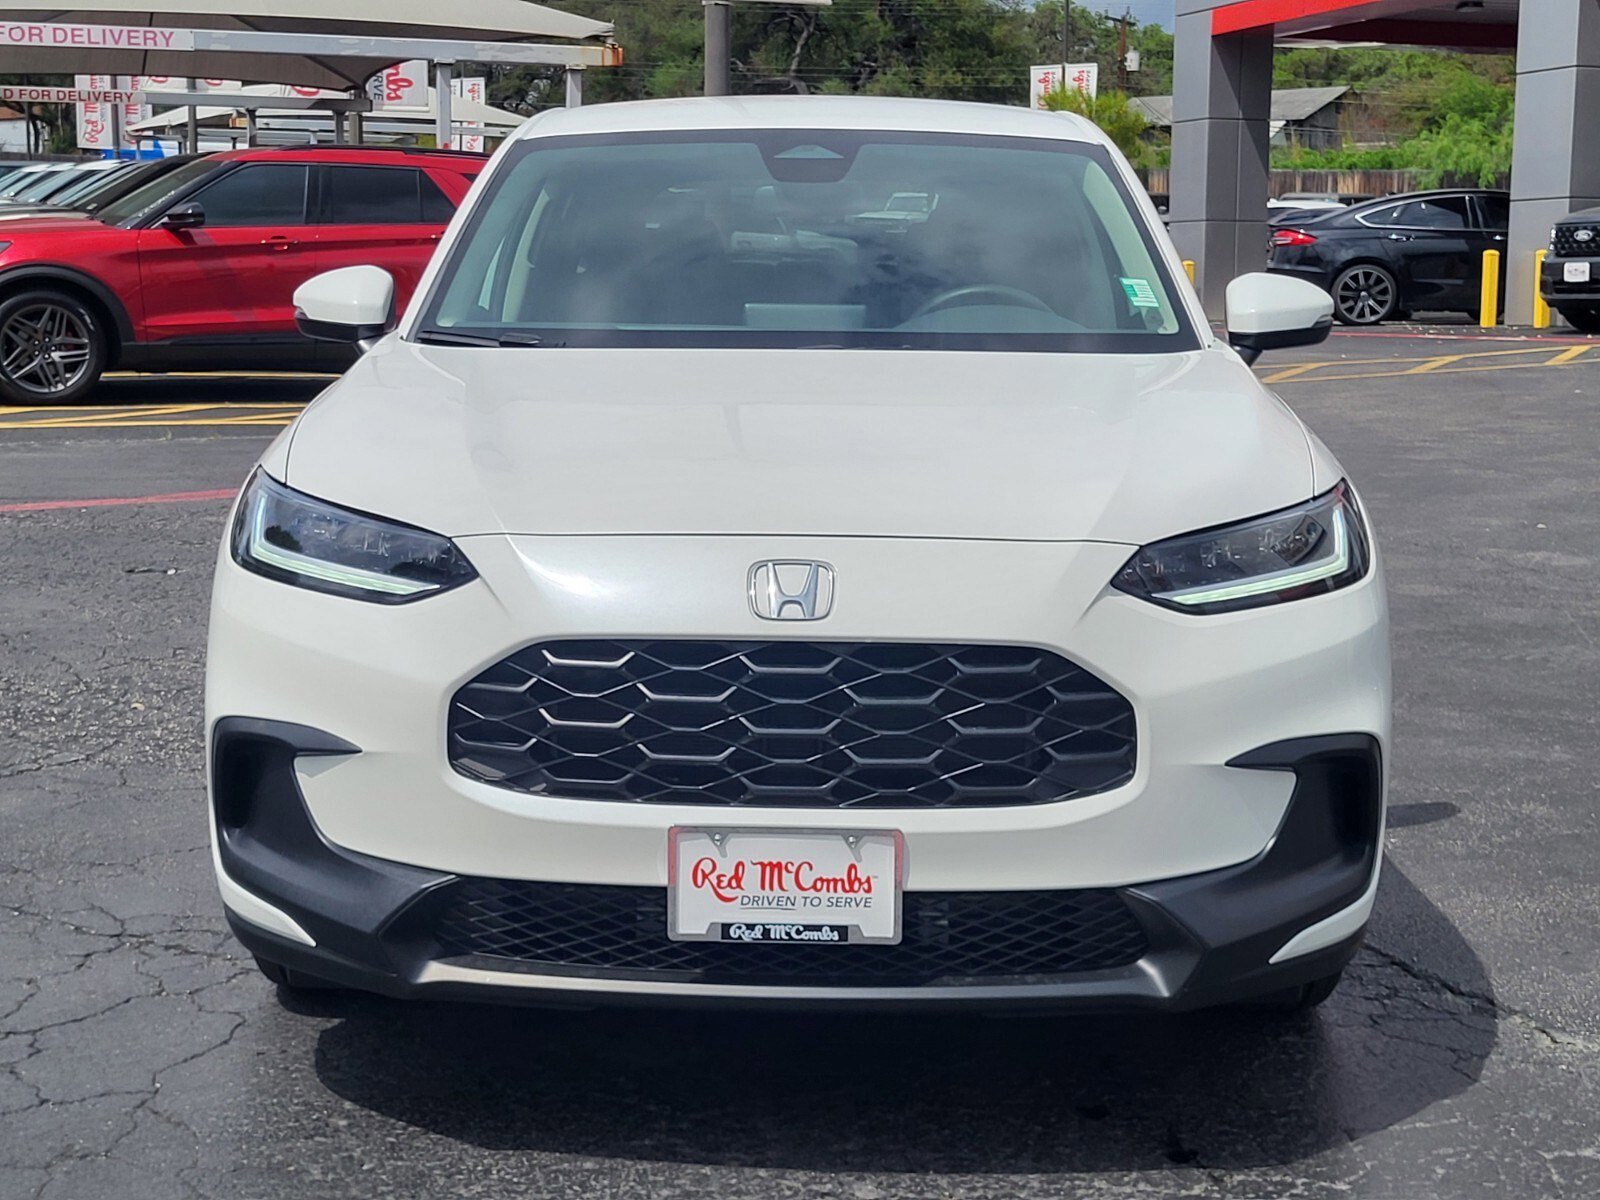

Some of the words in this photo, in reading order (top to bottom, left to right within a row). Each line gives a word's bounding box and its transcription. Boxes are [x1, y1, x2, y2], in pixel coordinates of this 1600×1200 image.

[52, 27, 175, 47] DELIVERY
[19, 89, 51, 100] FOR
[57, 90, 133, 103] DELIVERY
[85, 119, 105, 143] Red
[692, 857, 746, 903] Red
[751, 860, 872, 894] McCombs
[740, 895, 796, 907] DRIVEN
[800, 896, 822, 908] TO
[826, 896, 873, 908] SERVE
[729, 923, 763, 941] Red
[765, 924, 840, 941] McCombs
